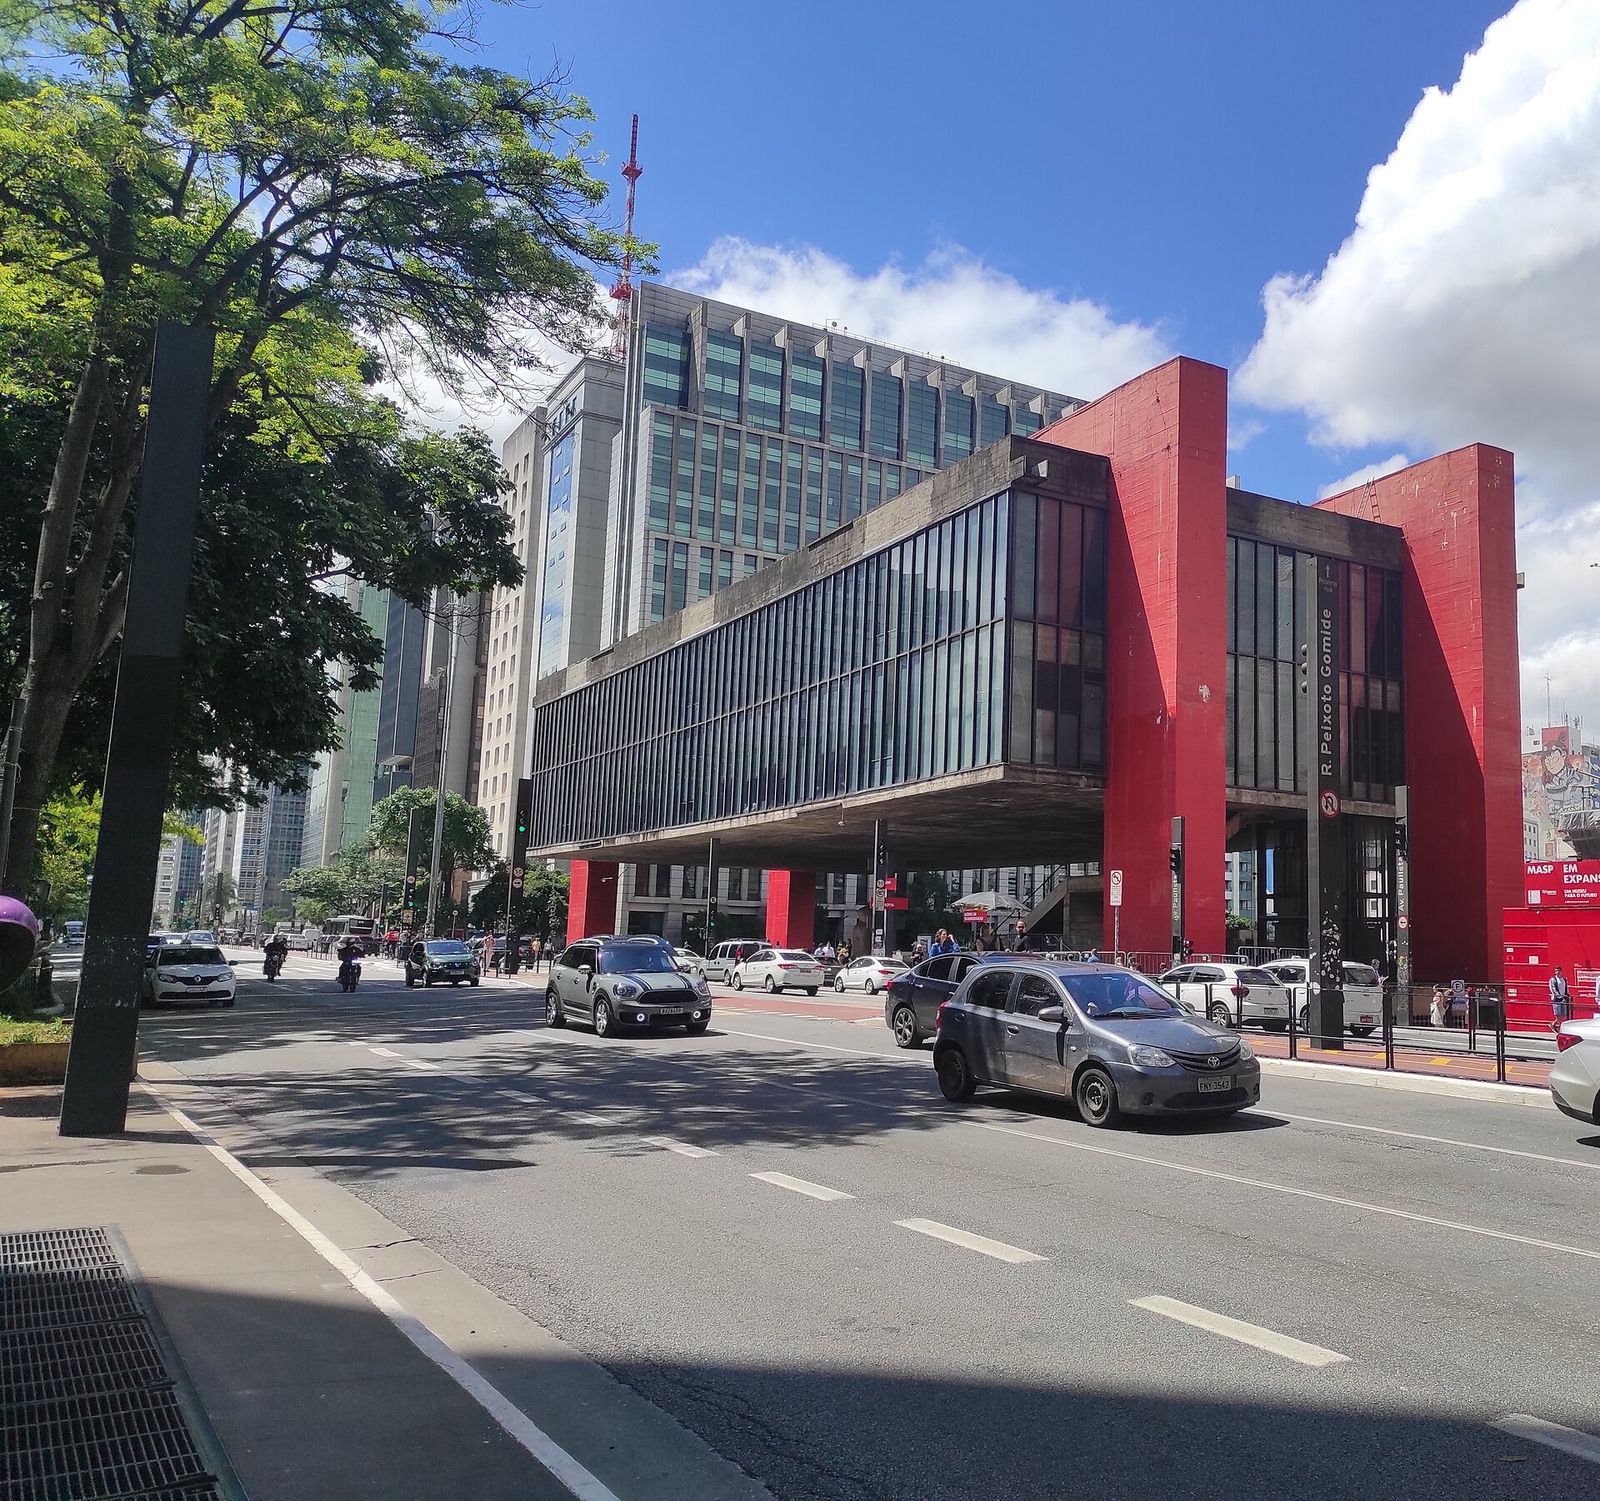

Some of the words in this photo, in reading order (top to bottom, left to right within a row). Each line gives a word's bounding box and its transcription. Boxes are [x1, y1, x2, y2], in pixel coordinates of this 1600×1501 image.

[1320, 608, 1332, 678] Gomide
[1320, 684, 1332, 755] Peixoto
[1321, 760, 1332, 776] R.
[1527, 864, 1554, 875] MASP
[1563, 863, 1578, 873] EM
[1213, 1081, 1229, 1090] 3542
